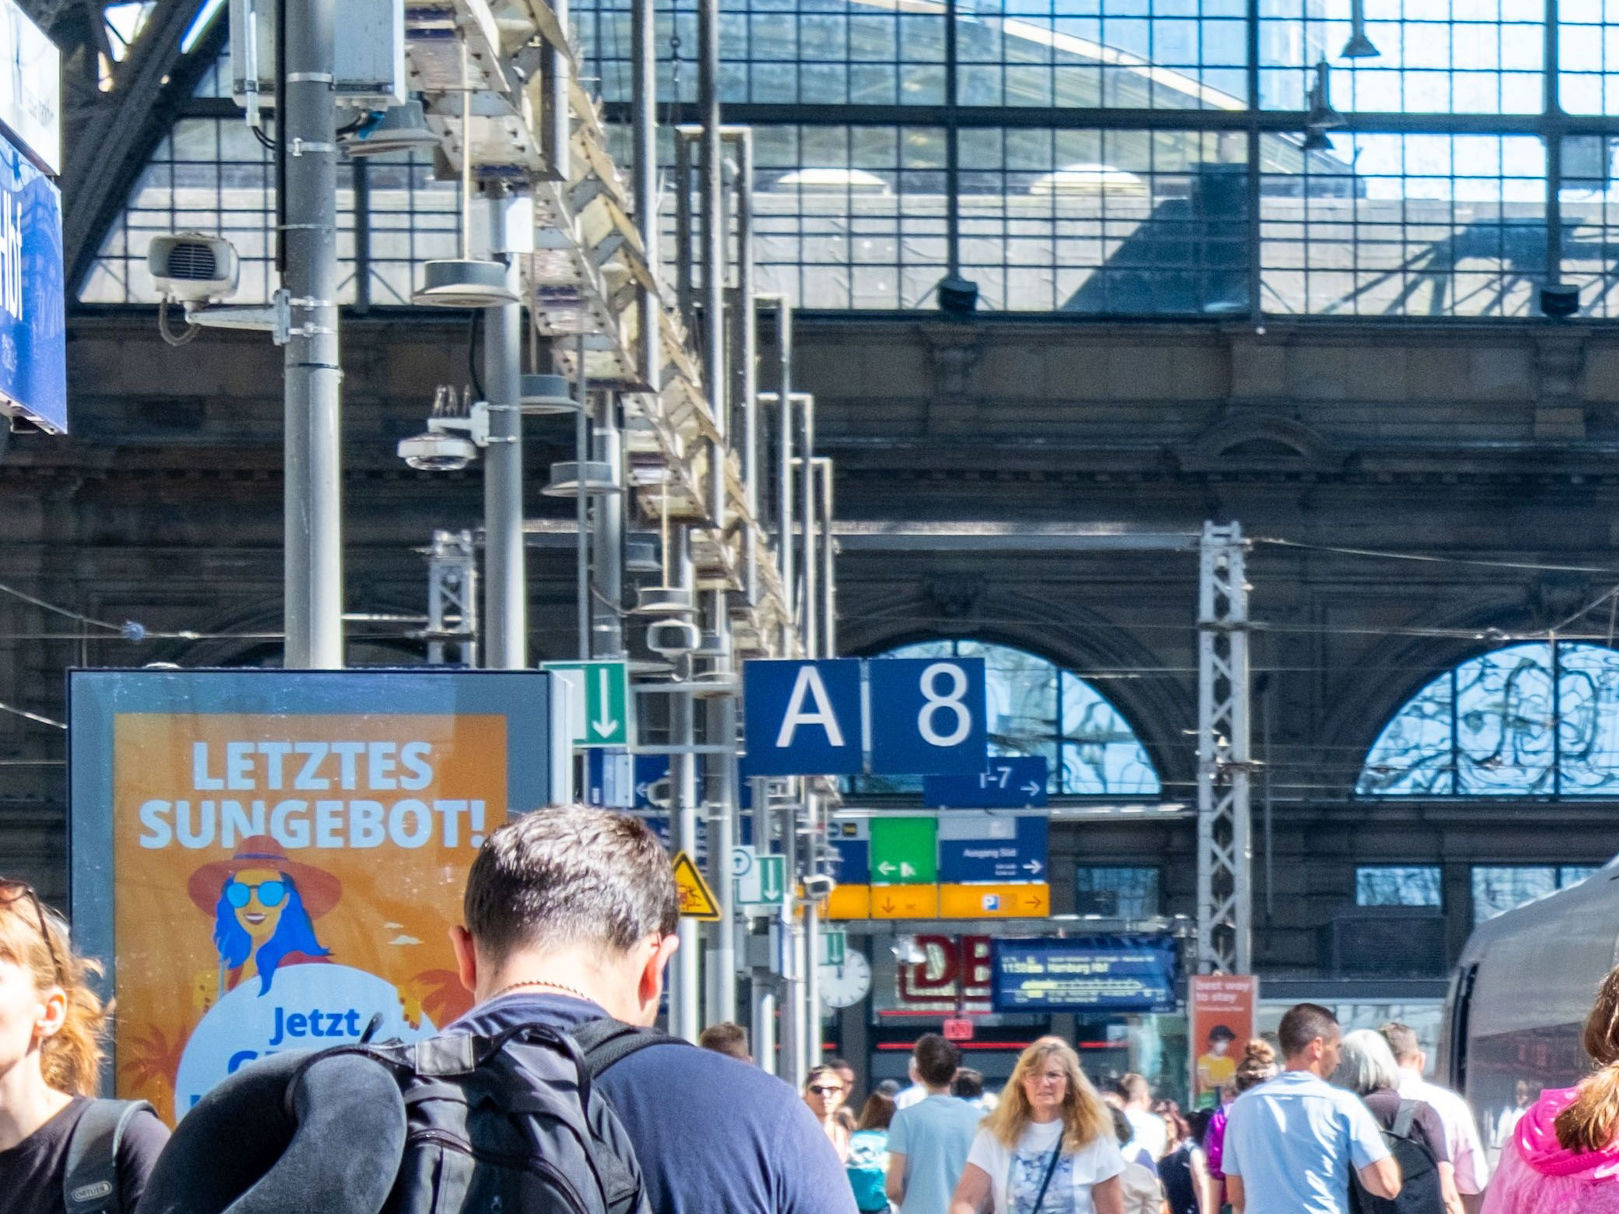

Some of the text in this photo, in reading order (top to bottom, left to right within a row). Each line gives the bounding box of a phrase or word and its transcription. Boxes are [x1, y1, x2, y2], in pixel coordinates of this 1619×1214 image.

[776, 662, 972, 748] A 8
[193, 741, 433, 790] LETZTES
[139, 799, 485, 849] SUNGEBOT!
[269, 1007, 361, 1046] Jetzt
